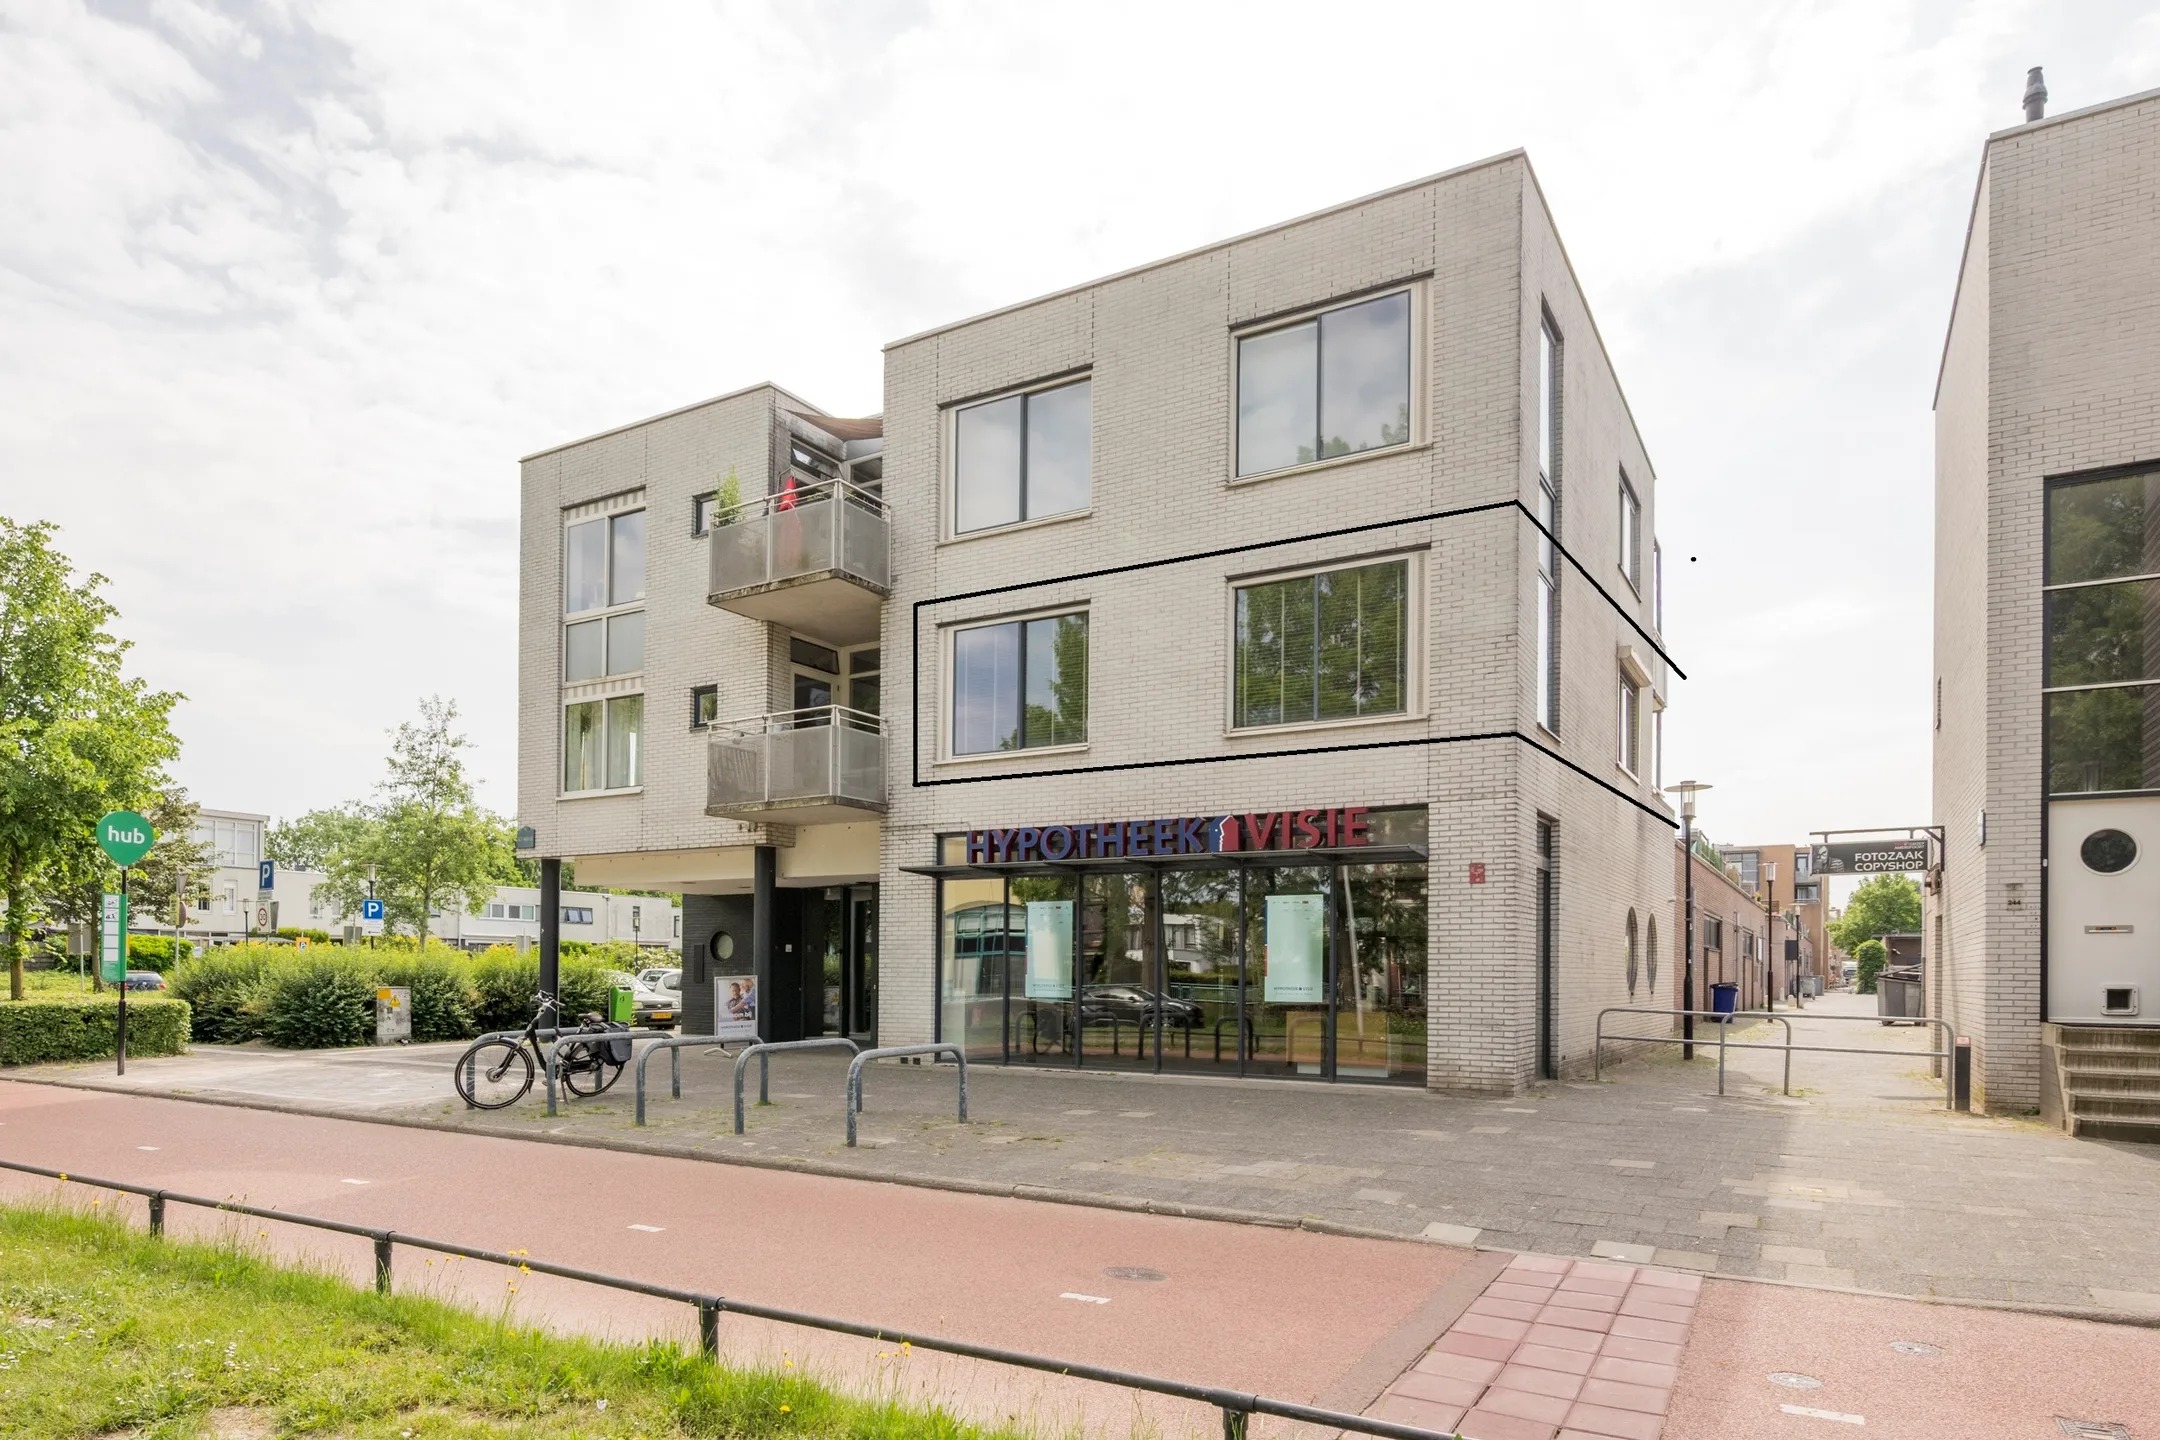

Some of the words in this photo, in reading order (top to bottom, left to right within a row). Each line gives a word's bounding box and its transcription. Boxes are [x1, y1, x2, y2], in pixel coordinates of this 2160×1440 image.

[107, 825, 146, 844] hub
[966, 816, 1206, 863] HYPOTHEEK
[1244, 806, 1370, 850] VISIE
[1854, 850, 1924, 862] FOTOZAAK
[1854, 861, 1924, 872] COPYSHOP
[261, 864, 271, 887] P
[368, 902, 379, 918] P
